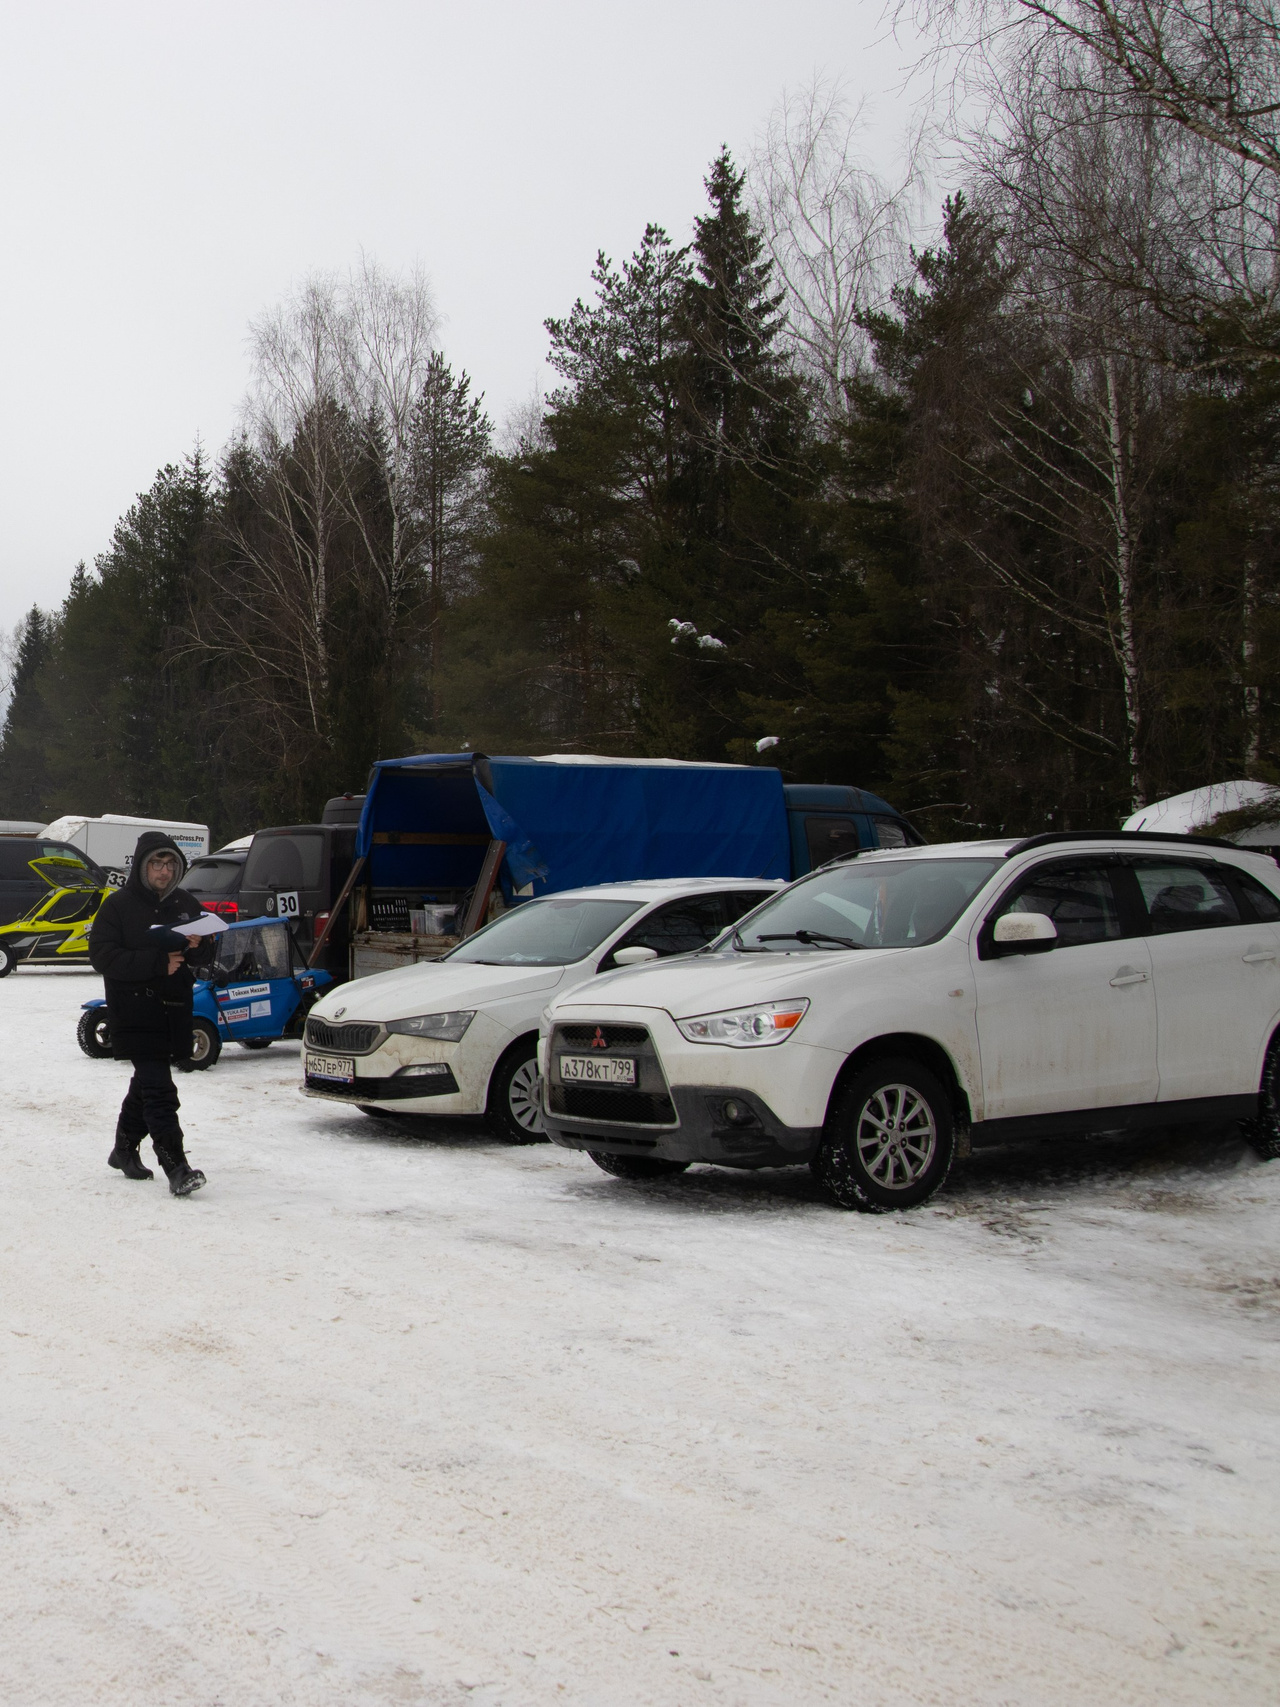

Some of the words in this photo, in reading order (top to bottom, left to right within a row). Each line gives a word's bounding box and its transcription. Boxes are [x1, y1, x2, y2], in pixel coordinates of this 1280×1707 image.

[108, 873, 127, 888] 33
[280, 895, 297, 914] 30
[337, 1060, 351, 1073] 977
[564, 1059, 609, 1080] А378КТ
[612, 1060, 631, 1076] 799
